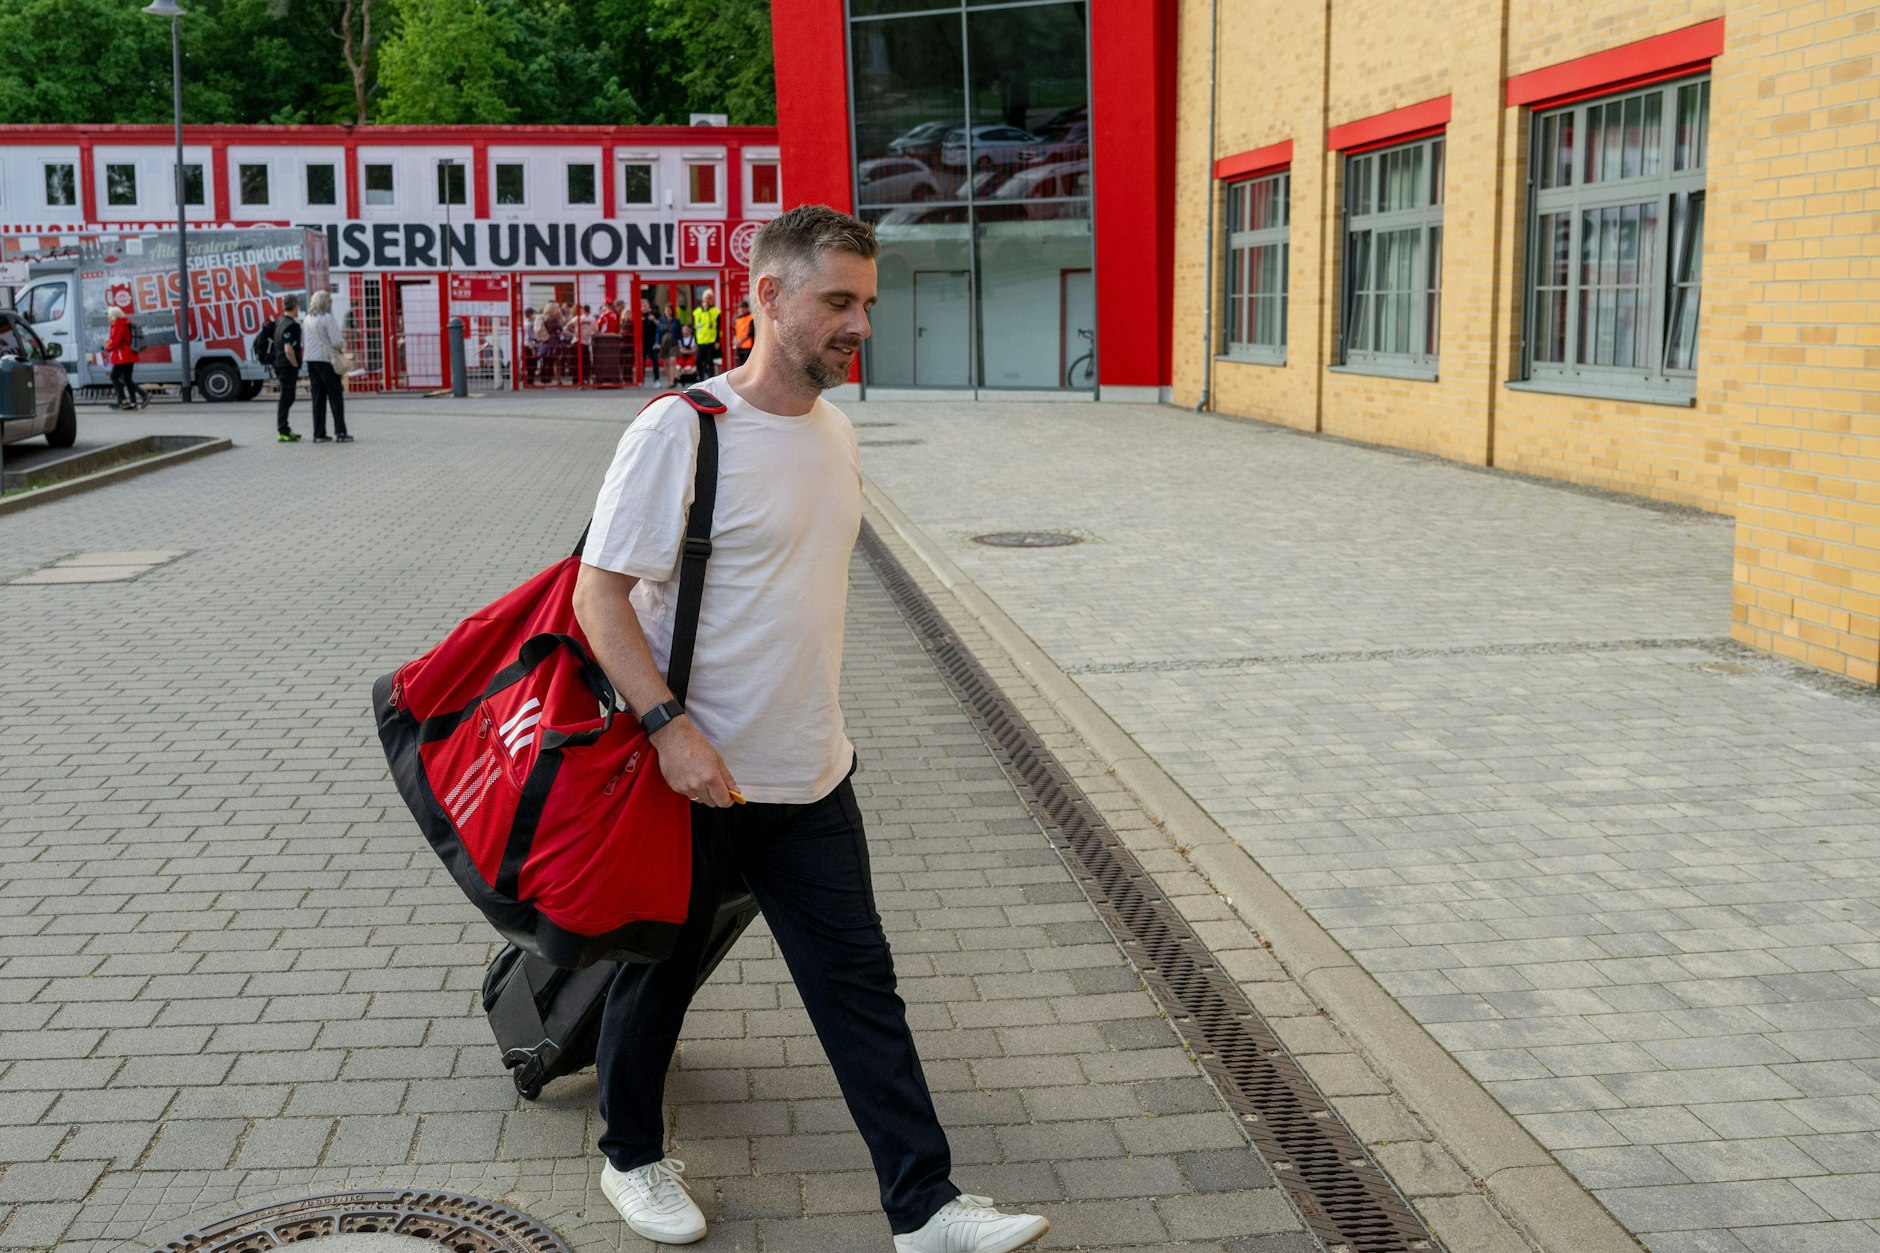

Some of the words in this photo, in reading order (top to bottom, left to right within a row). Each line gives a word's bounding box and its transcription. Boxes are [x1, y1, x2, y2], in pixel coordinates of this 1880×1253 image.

[184, 237, 240, 253] örsterei
[186, 245, 302, 270] SPIELFELDKÜCHE
[295, 223, 476, 267] ISERN
[488, 223, 675, 267] UNION!
